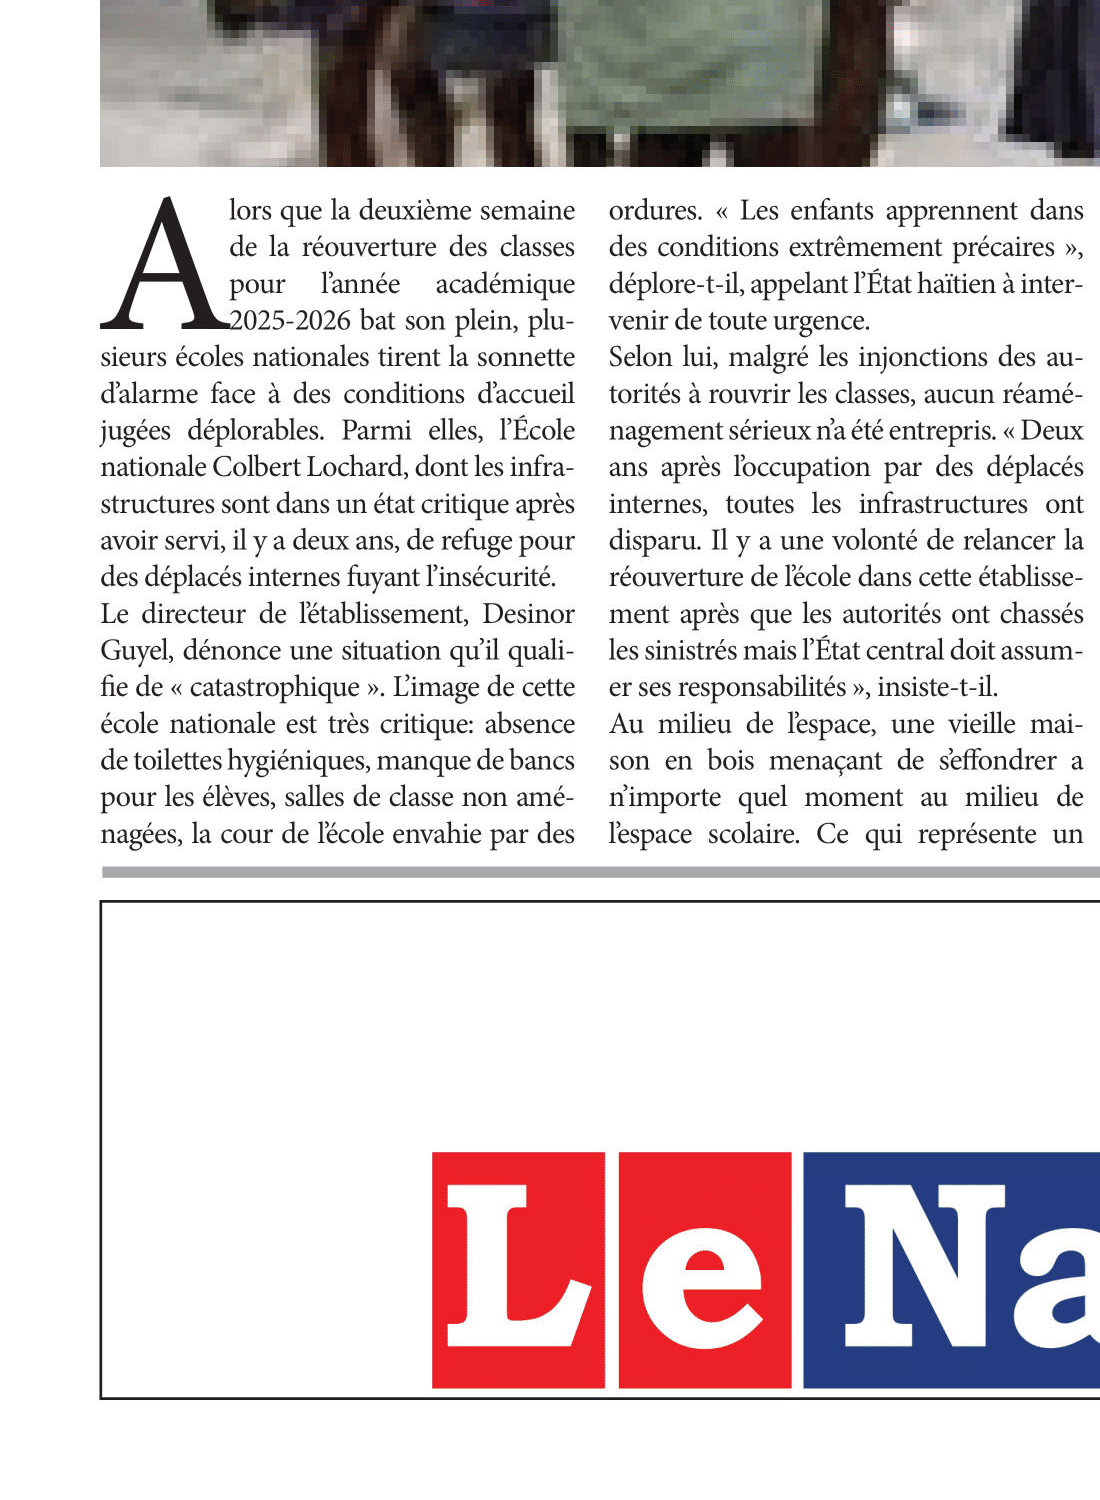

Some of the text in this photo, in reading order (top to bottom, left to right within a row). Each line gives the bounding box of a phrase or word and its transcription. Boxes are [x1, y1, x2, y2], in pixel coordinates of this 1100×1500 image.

[229, 197, 576, 228] lors que la deuxième semaine
[229, 233, 575, 257] de la réouverture des classes
[229, 307, 574, 338] 2025-2026 bat son plein, plu-
[608, 307, 870, 338] venir de toute urgence.
[100, 343, 576, 367] sieurs écoles nationales tirent la sonnette
[609, 343, 1083, 375] Selon lui, malgré les injonctions des au-
[100, 453, 574, 480] nationale Colbert Lochard, dont les infra-
[609, 527, 1085, 558] disparu. Il y a une volonté de relancer la
[608, 600, 1084, 631] ment après que les autorités ont chassés
[100, 710, 576, 741] école nationale est très critique: absence
[100, 783, 574, 814] pour les élèves, salles de classe non amé-
